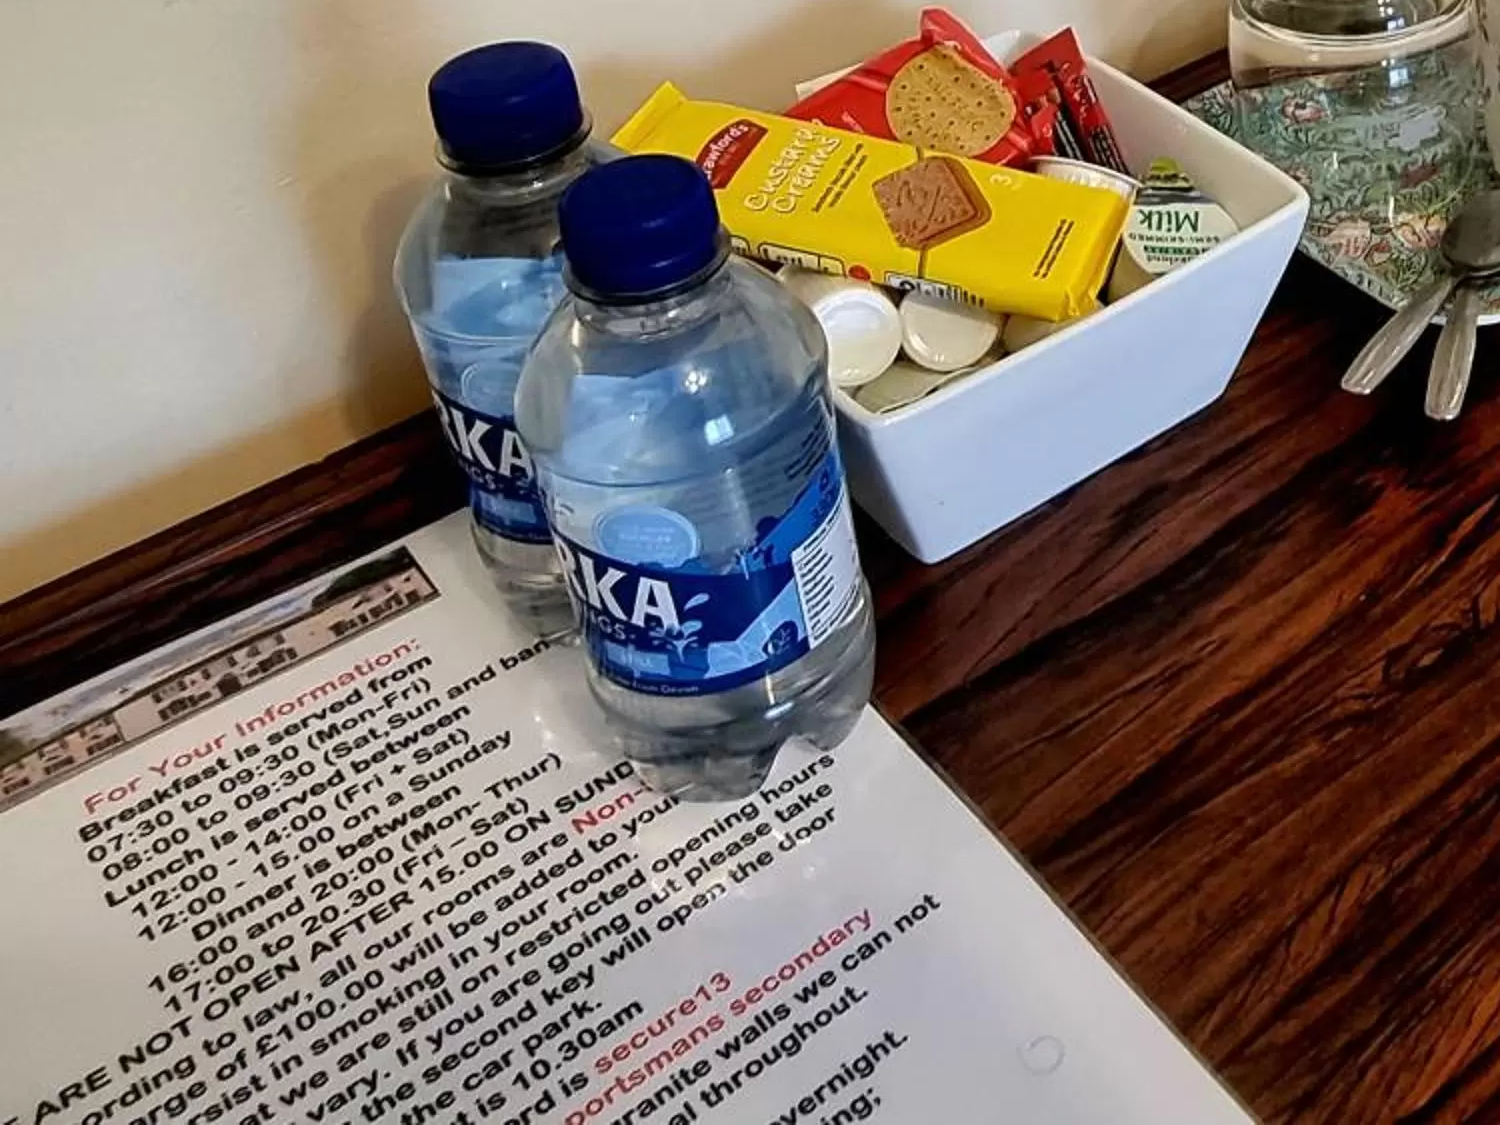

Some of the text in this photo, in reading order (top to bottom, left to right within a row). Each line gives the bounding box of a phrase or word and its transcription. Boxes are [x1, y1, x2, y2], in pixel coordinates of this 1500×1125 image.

[1138, 209, 1199, 233] Milk
[77, 655, 432, 843] Breakfast is served from
[83, 776, 141, 815] For
[147, 733, 226, 777] Your
[86, 676, 431, 864] 07:30 to 09:30 (Mon-Fri)
[101, 826, 190, 881] 08:00
[195, 809, 229, 832] to
[232, 759, 316, 811] 09:30
[445, 663, 497, 700] and
[103, 704, 471, 908] Lunch is served between
[130, 863, 219, 918] 12:00
[243, 803, 327, 855] 14:00
[332, 772, 384, 812] (Fri
[388, 763, 407, 775] +
[410, 727, 470, 765] Sat)
[137, 885, 227, 941] 12:00
[251, 825, 336, 877] 15.00
[341, 803, 380, 831] on
[384, 790, 405, 807] a
[407, 729, 511, 793] Sunday
[147, 751, 562, 993] 16:00 and 20:00 (Mon- Thur)
[163, 952, 255, 1013] 17:00
[259, 933, 295, 959] to
[299, 877, 386, 937] 20.30
[392, 842, 445, 885] (Fri
[468, 796, 529, 837] Sat)
[190, 784, 462, 942] Dinner is between
[200, 1030, 238, 1058] to
[241, 989, 314, 1034] law,
[317, 953, 358, 989] all
[362, 920, 414, 960] our
[421, 863, 516, 926] rooms
[520, 831, 569, 867] are
[214, 1046, 248, 1082] of
[254, 968, 384, 1059] £100.00
[388, 931, 445, 973] will
[446, 909, 489, 940] be
[493, 847, 585, 912] added
[586, 831, 618, 854] to
[277, 1069, 329, 1107] we
[335, 1030, 391, 1073] are
[396, 986, 455, 1034] still
[459, 962, 500, 994] on
[503, 867, 647, 967] restricted
[650, 794, 760, 874] opening
[760, 752, 836, 805] hours
[304, 783, 833, 1125] vary. If you are going out please take
[729, 908, 871, 1016] secondary
[30, 1065, 113, 1125] ARE
[117, 1014, 193, 1074] NOT
[202, 954, 300, 1022] OPEN
[309, 889, 414, 963] AFTER
[418, 839, 499, 892] 15.00
[503, 808, 551, 844] ON
[267, 1053, 304, 1081] in
[308, 965, 446, 1056] smoking
[446, 945, 480, 970] in
[482, 898, 549, 954] your
[555, 851, 639, 904] room.
[359, 806, 837, 1125] the second key will open the door
[461, 1047, 515, 1092] car
[520, 999, 603, 1058] park.
[472, 1000, 644, 1118] is 10.30am
[556, 1070, 590, 1099] is
[593, 971, 731, 1074] secure13
[610, 893, 941, 1125] ranite walls we can not
[699, 986, 868, 1108] throughout.
[770, 1030, 908, 1125] vernight.
